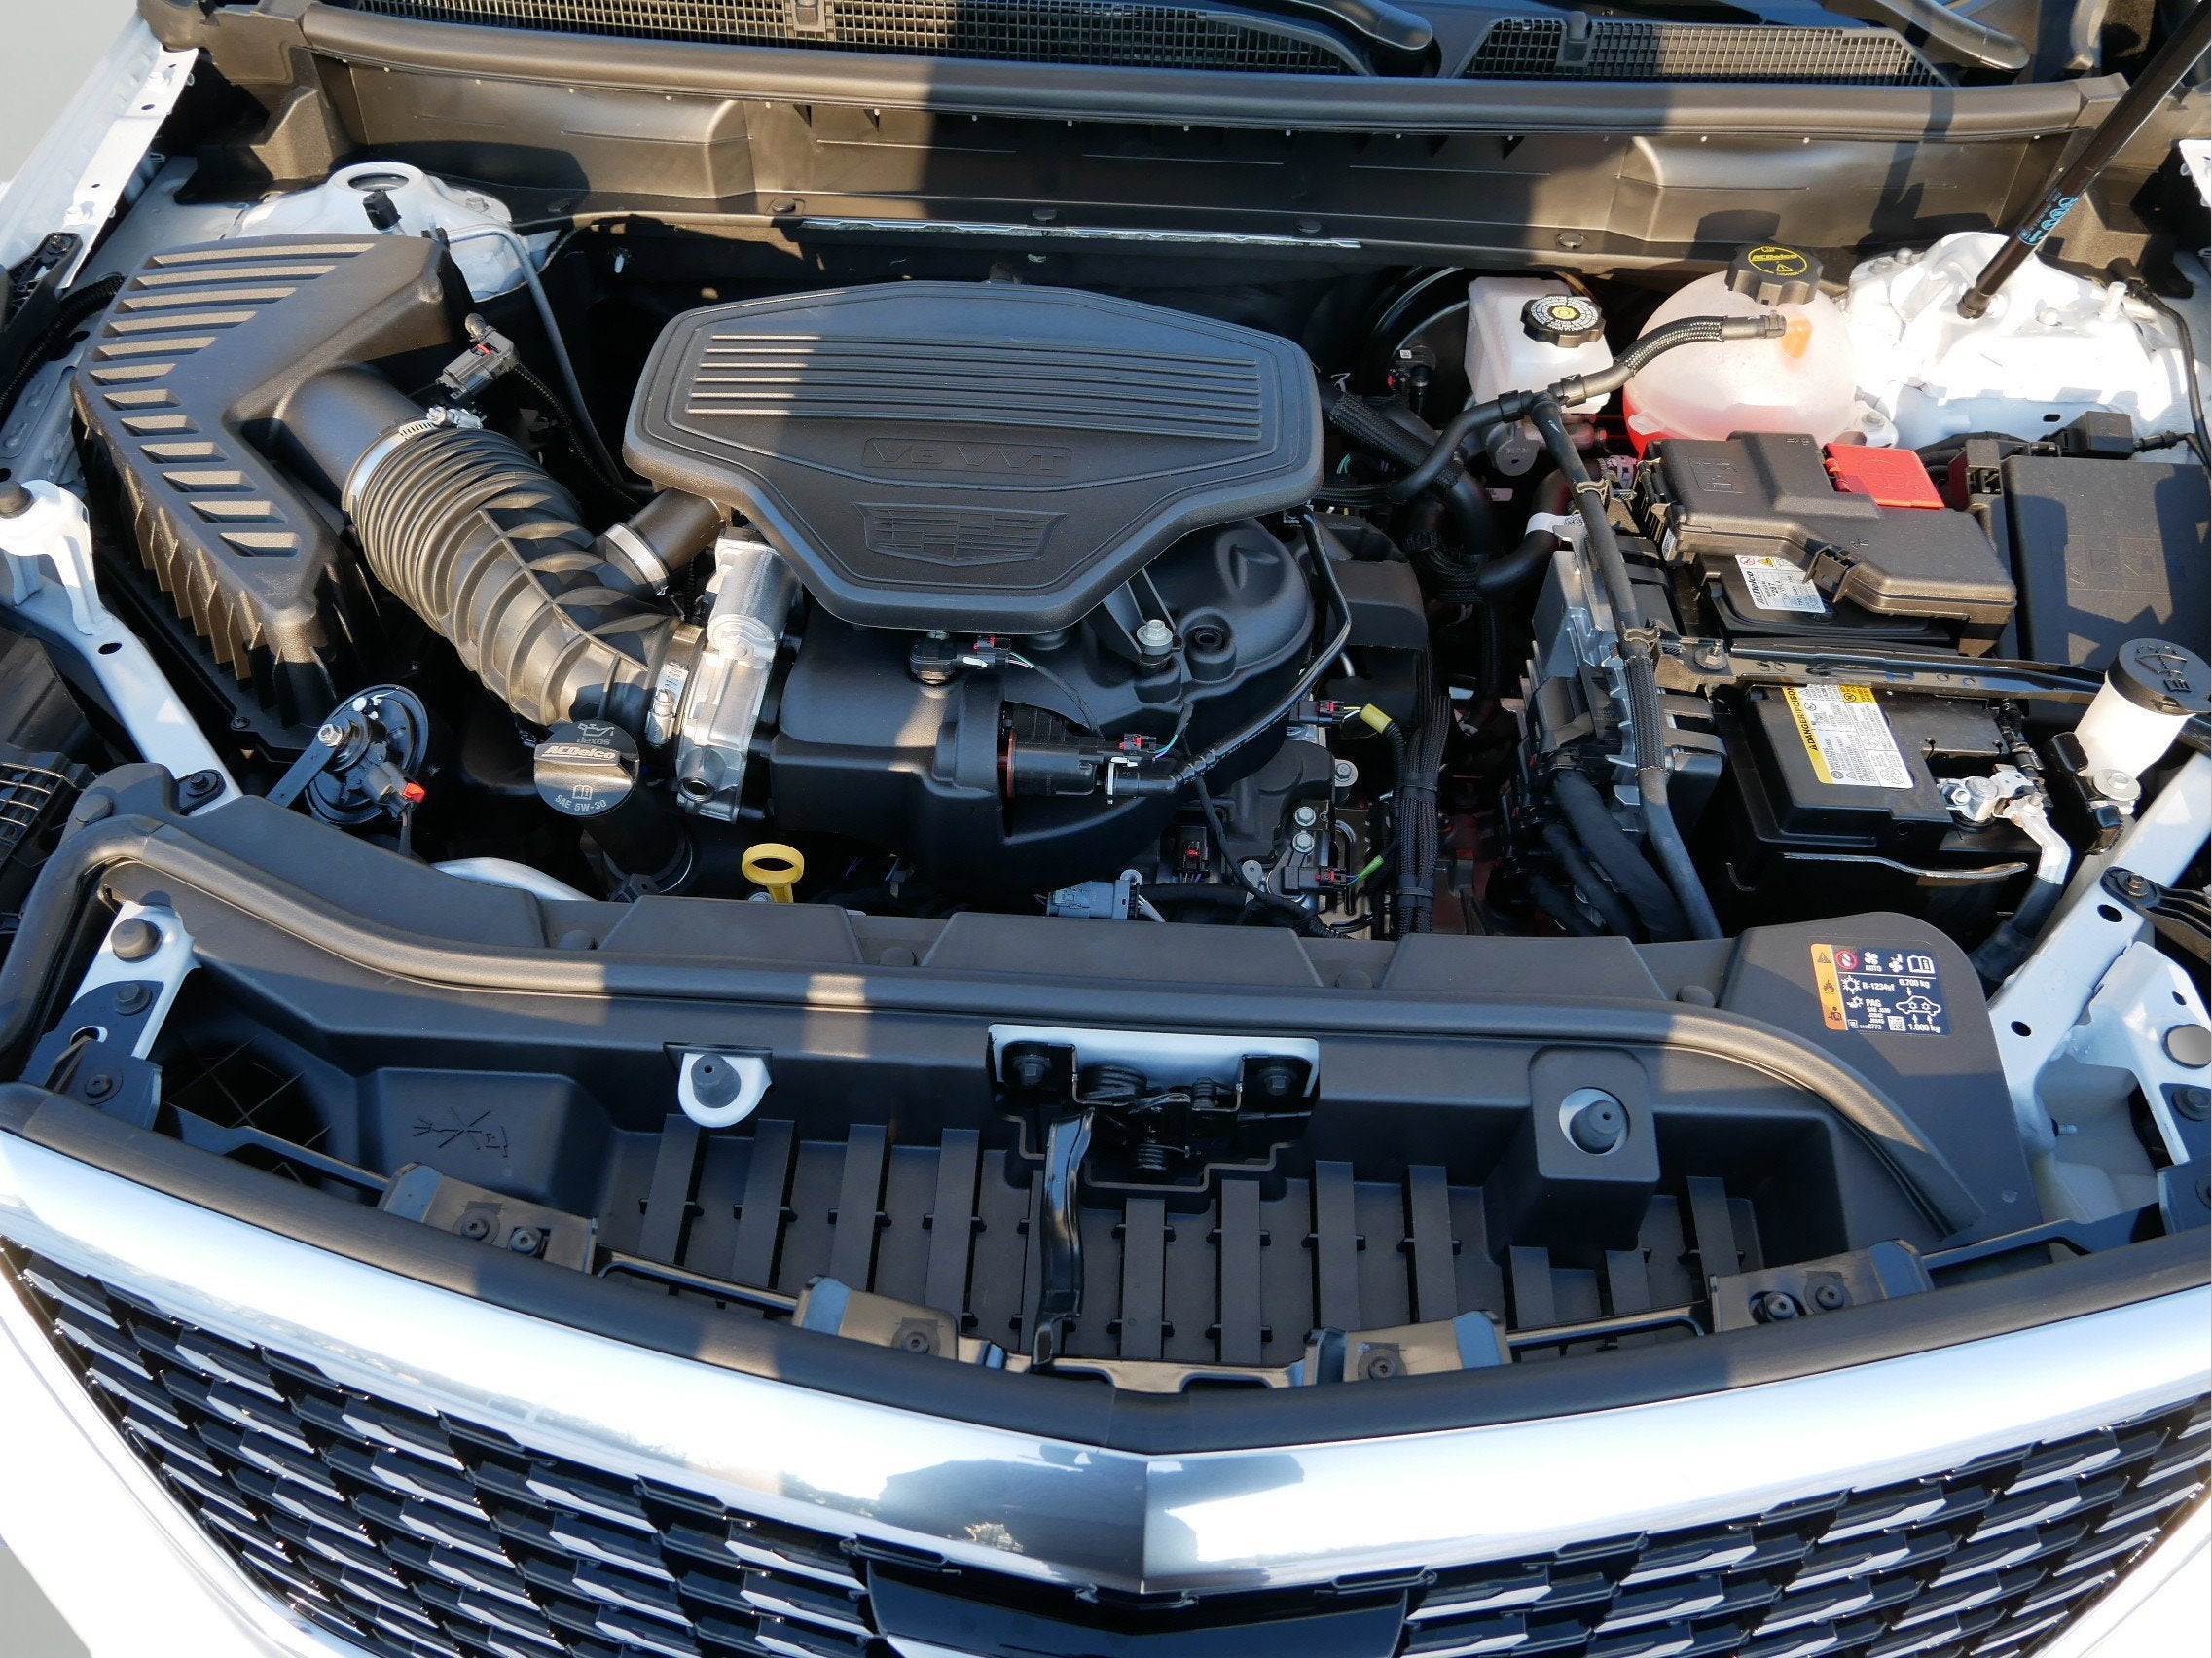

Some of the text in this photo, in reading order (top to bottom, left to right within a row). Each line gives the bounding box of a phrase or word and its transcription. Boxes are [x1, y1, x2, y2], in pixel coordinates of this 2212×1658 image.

[873, 443, 1066, 471] V6 VVT
[1746, 570, 1765, 605] ACDelco
[576, 737, 610, 745] dexos
[543, 745, 617, 760] ACDelco
[555, 794, 607, 811] SAE 5W-30
[1862, 983, 1895, 991] R-1234yf
[1920, 979, 1930, 989] kg
[1907, 1023, 1940, 1033] 1.000 kg
